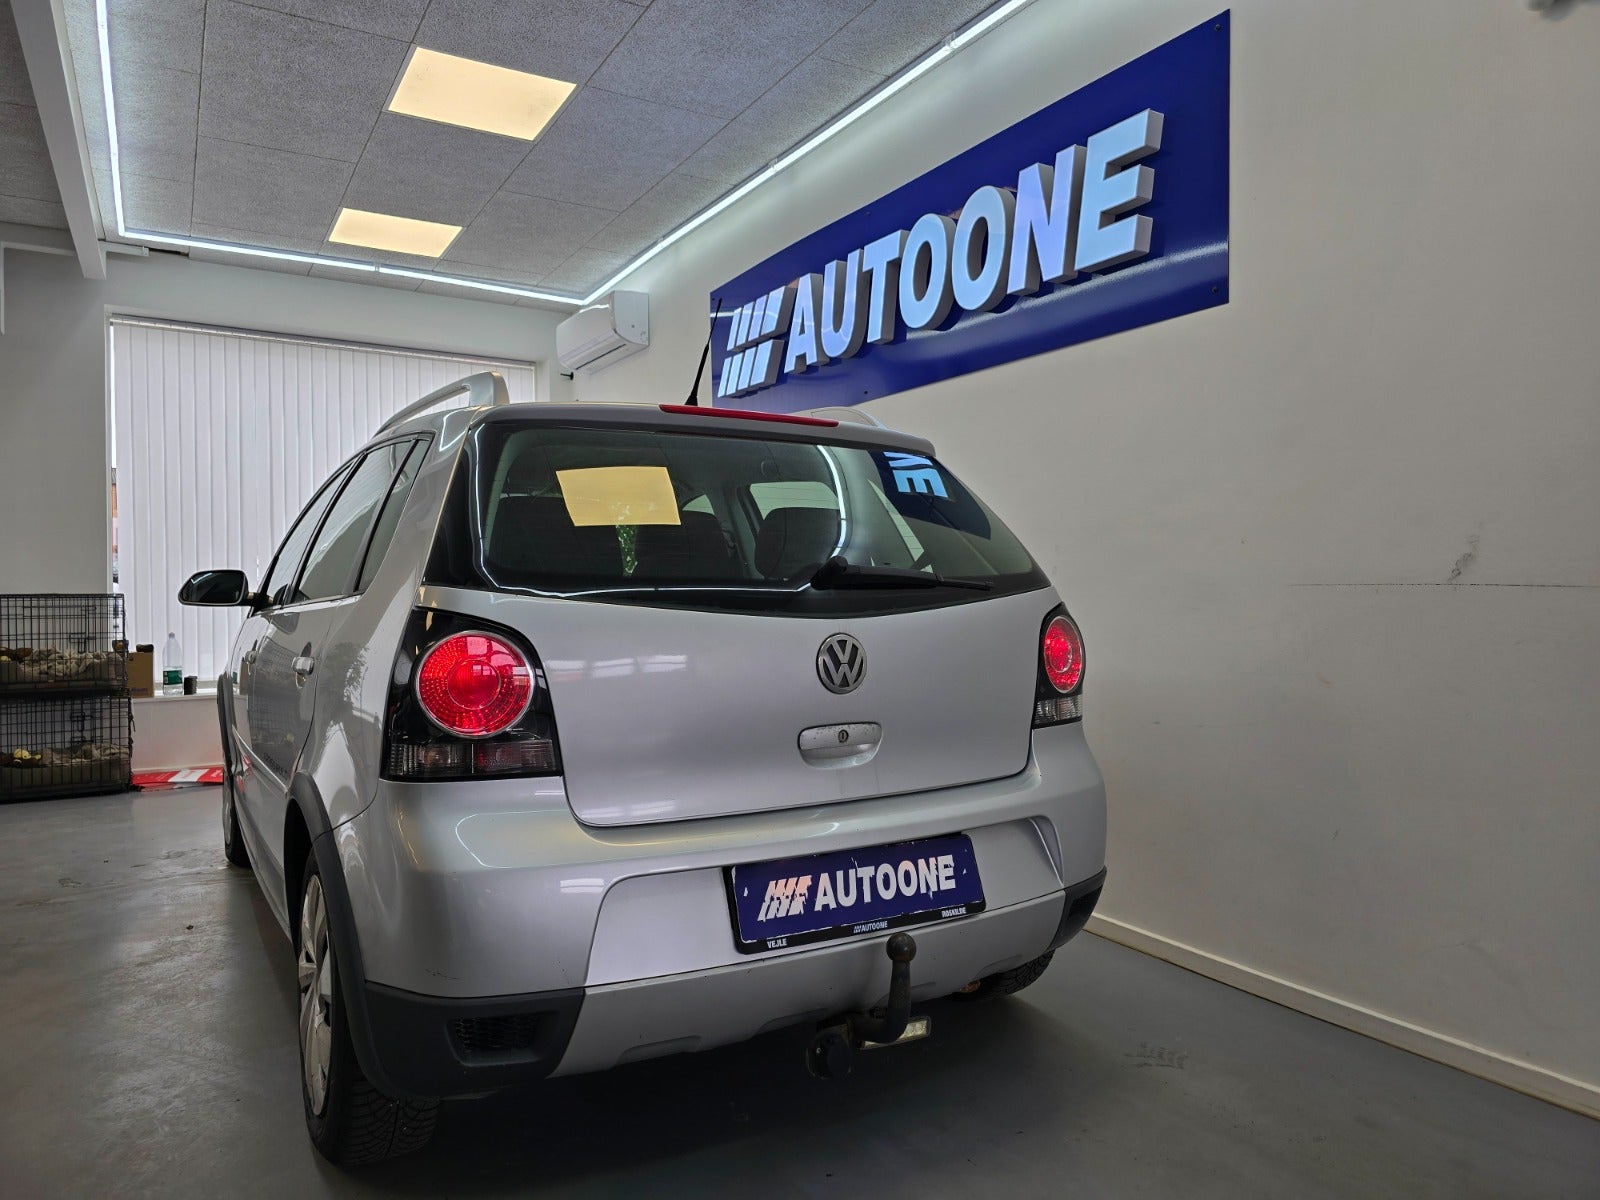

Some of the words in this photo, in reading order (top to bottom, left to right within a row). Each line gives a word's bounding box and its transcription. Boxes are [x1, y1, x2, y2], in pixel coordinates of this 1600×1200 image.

[784, 109, 1164, 374] AUTOONE
[814, 854, 956, 911] AUTOONE
[861, 921, 888, 932] AUTOONE
[767, 939, 787, 949] VEJLE
